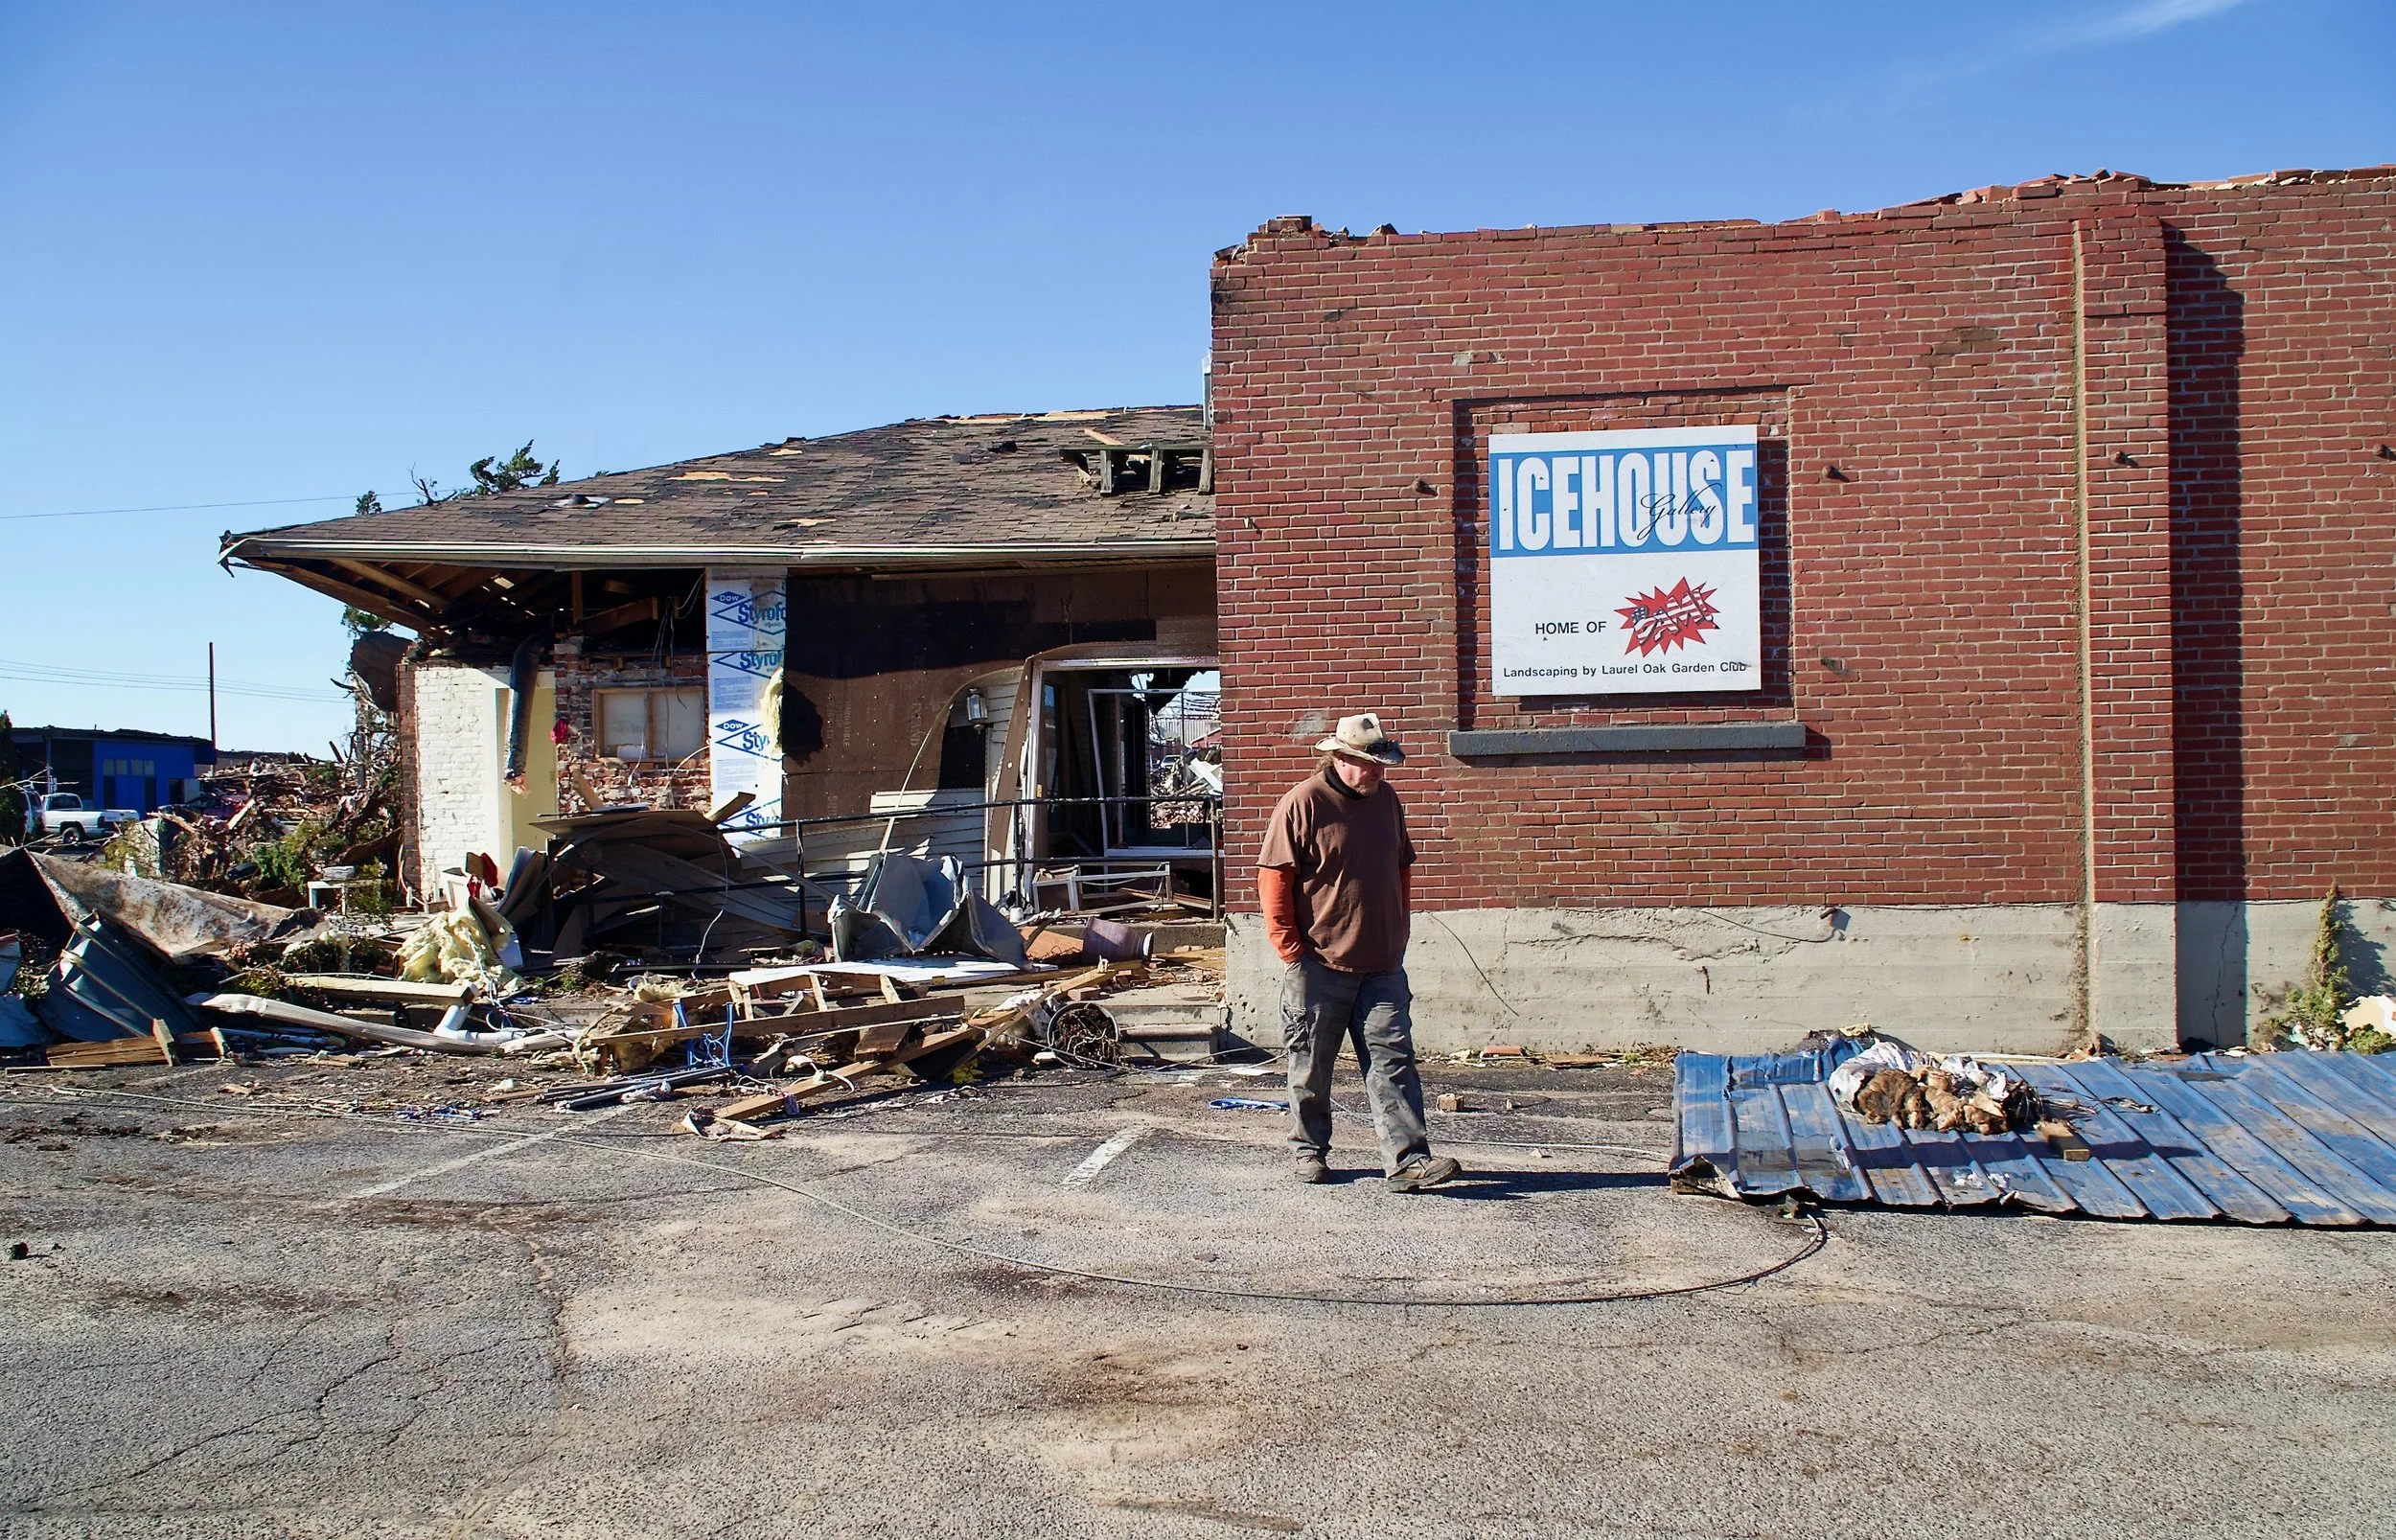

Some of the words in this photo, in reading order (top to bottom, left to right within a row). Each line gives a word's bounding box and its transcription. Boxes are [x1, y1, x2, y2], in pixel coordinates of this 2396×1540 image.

[1498, 448, 1755, 551] ICEHOUSE
[1637, 483, 1722, 540] Gallery
[1535, 622, 1579, 635] HOME
[1586, 621, 1607, 633] OF
[1504, 665, 1578, 678] Landscaping
[1582, 665, 1597, 678] by
[1601, 664, 1638, 675] Laurel
[1643, 662, 1667, 674] Oak
[1672, 661, 1715, 673] Garden
[1720, 660, 1747, 672] Club
